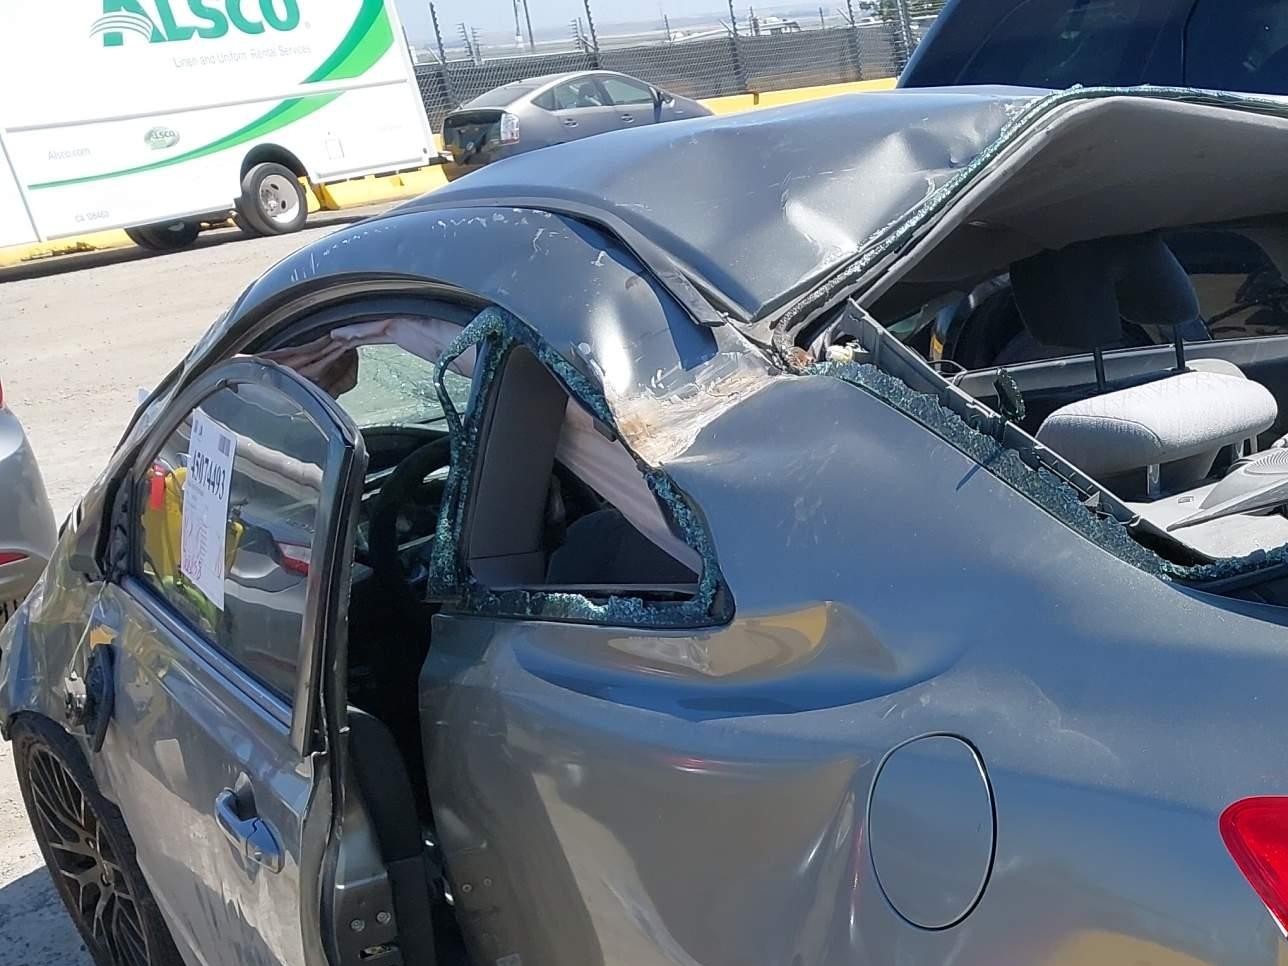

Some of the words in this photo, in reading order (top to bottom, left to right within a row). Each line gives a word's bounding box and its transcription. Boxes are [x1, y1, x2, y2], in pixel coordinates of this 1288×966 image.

[102, 0, 301, 47] ALSCO
[200, 54, 216, 66] and
[217, 50, 248, 65] Uniform
[278, 44, 312, 57] Services
[190, 449, 226, 500] 45074493
